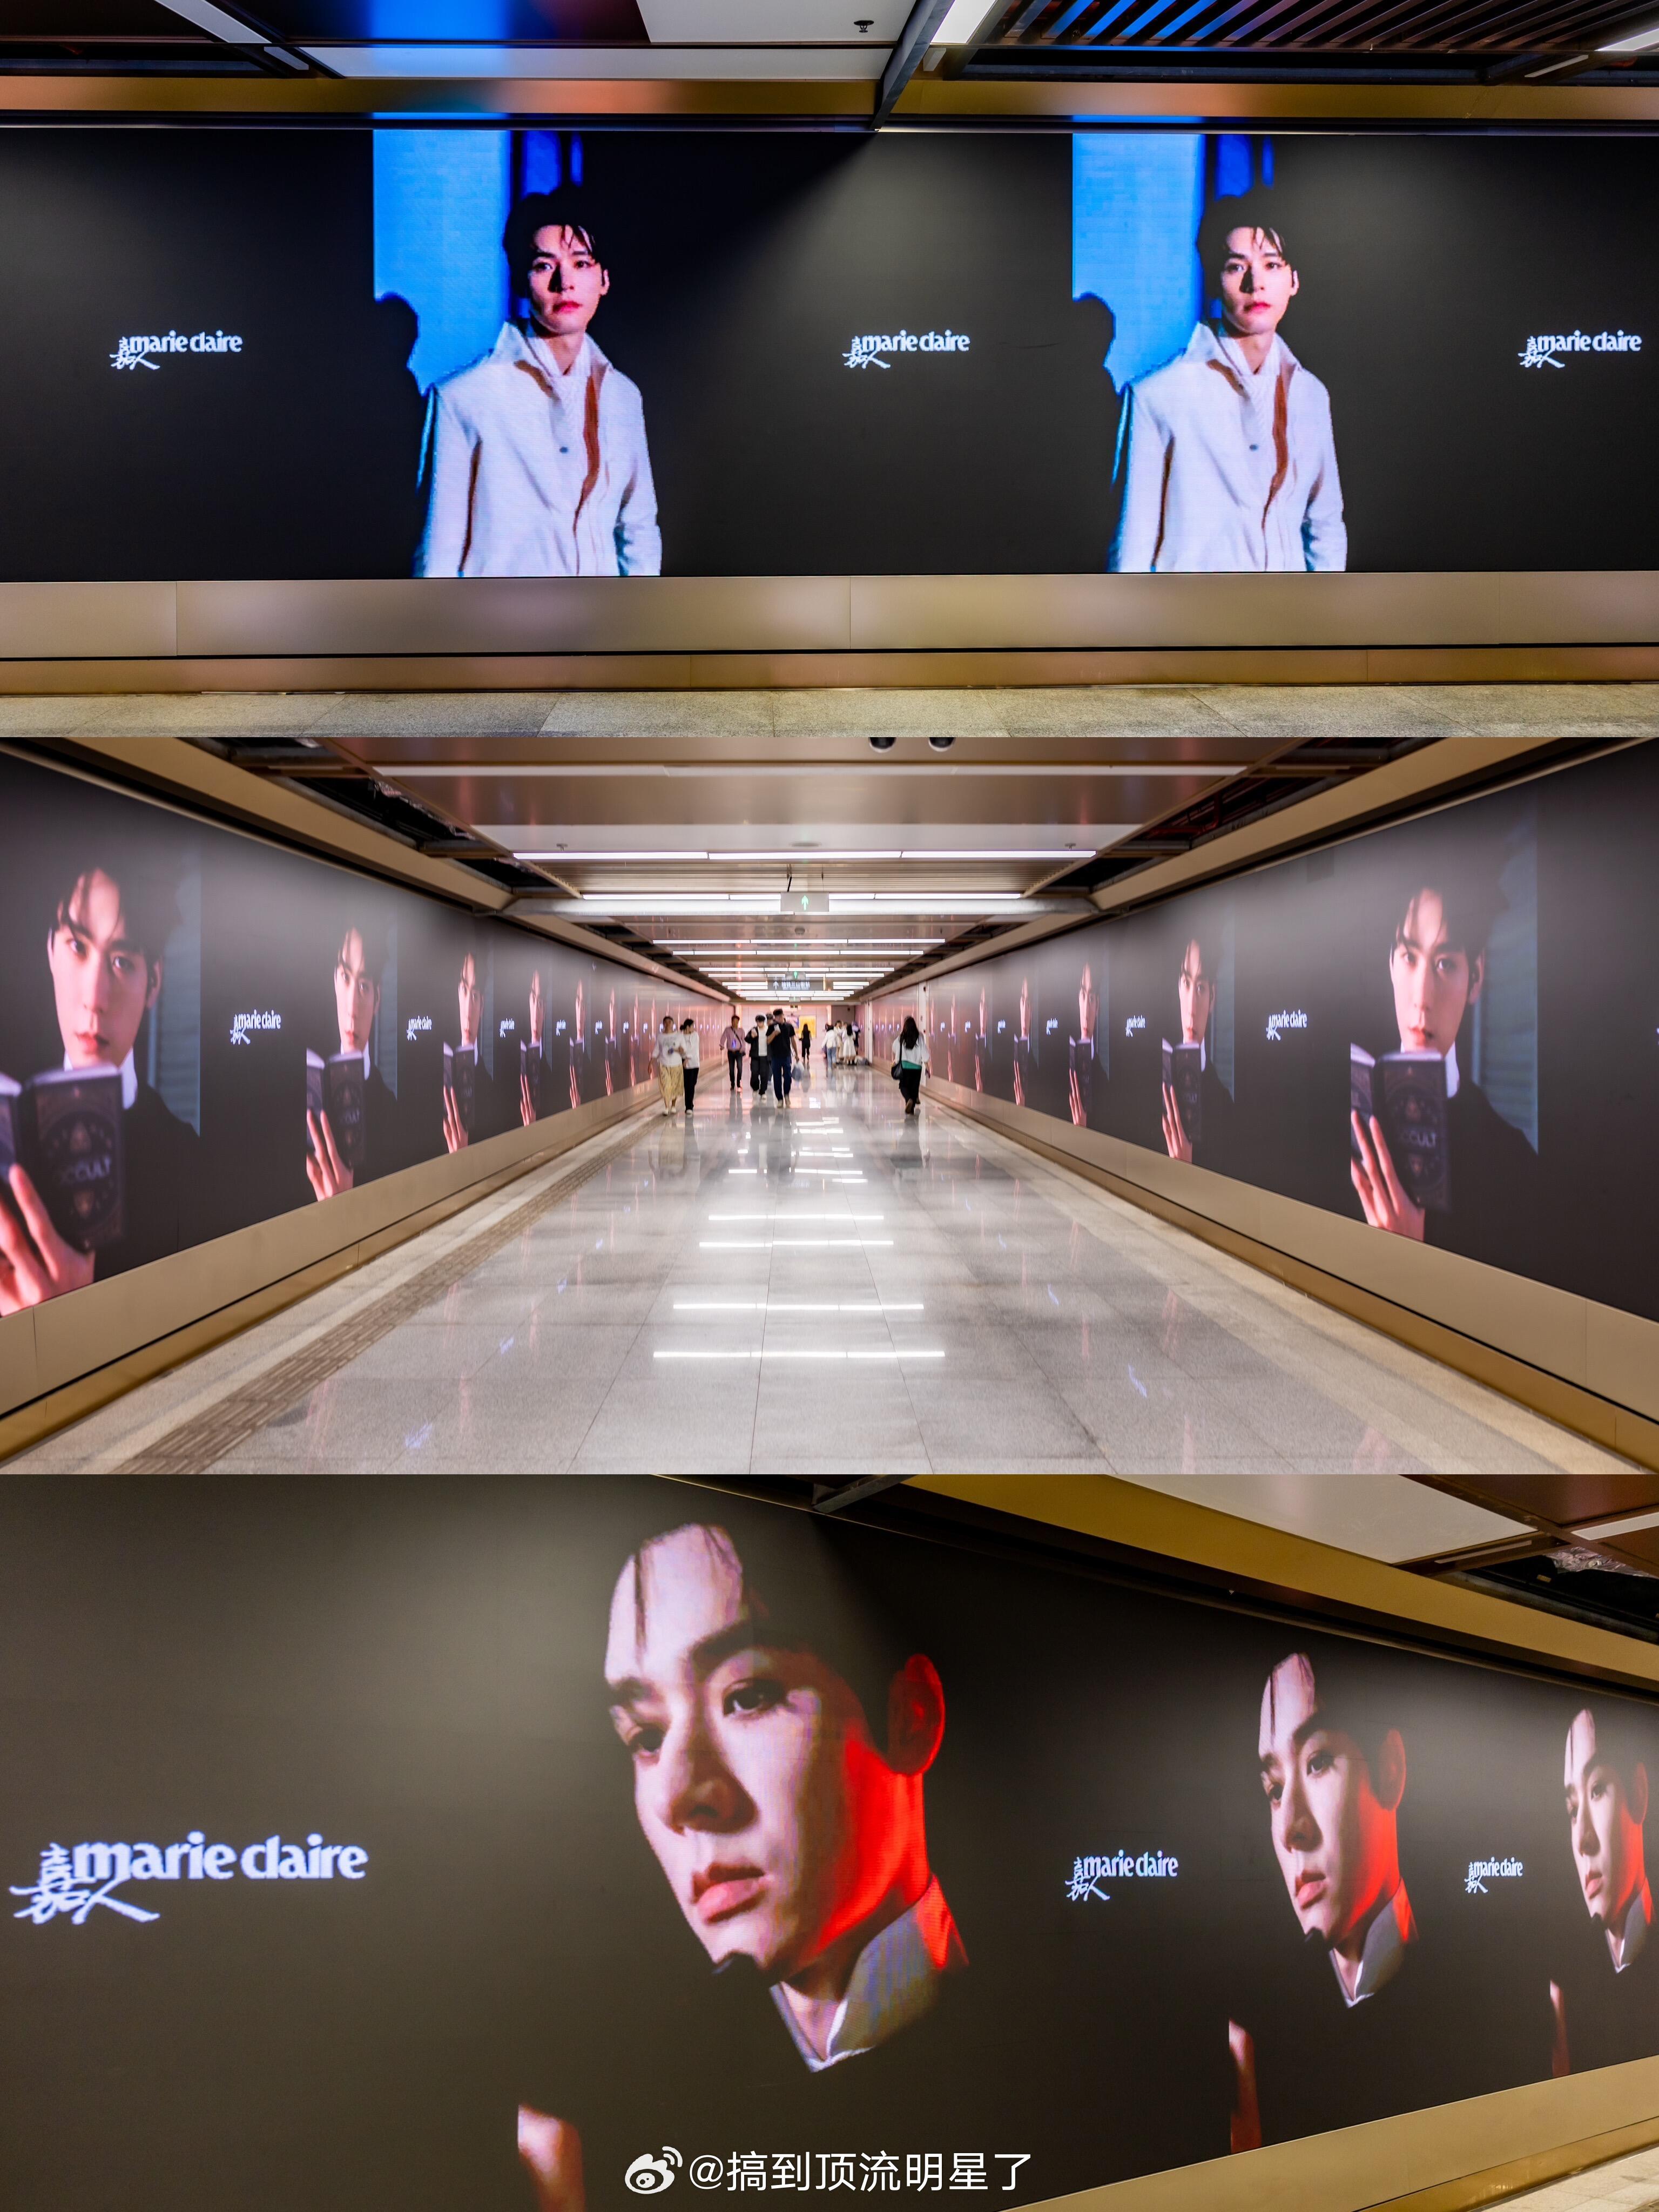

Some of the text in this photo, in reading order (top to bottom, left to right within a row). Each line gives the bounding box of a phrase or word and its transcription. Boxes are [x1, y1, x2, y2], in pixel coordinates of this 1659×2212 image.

[129, 330, 243, 353] marie claire
[861, 329, 970, 352] marie claire
[1537, 329, 1642, 352] marie claire
[238, 1009, 281, 1029] marie claire
[72, 1831, 369, 1879] marie claire
[1083, 1849, 1179, 1877] marie claire
[1473, 1856, 1523, 1877] marie claire
